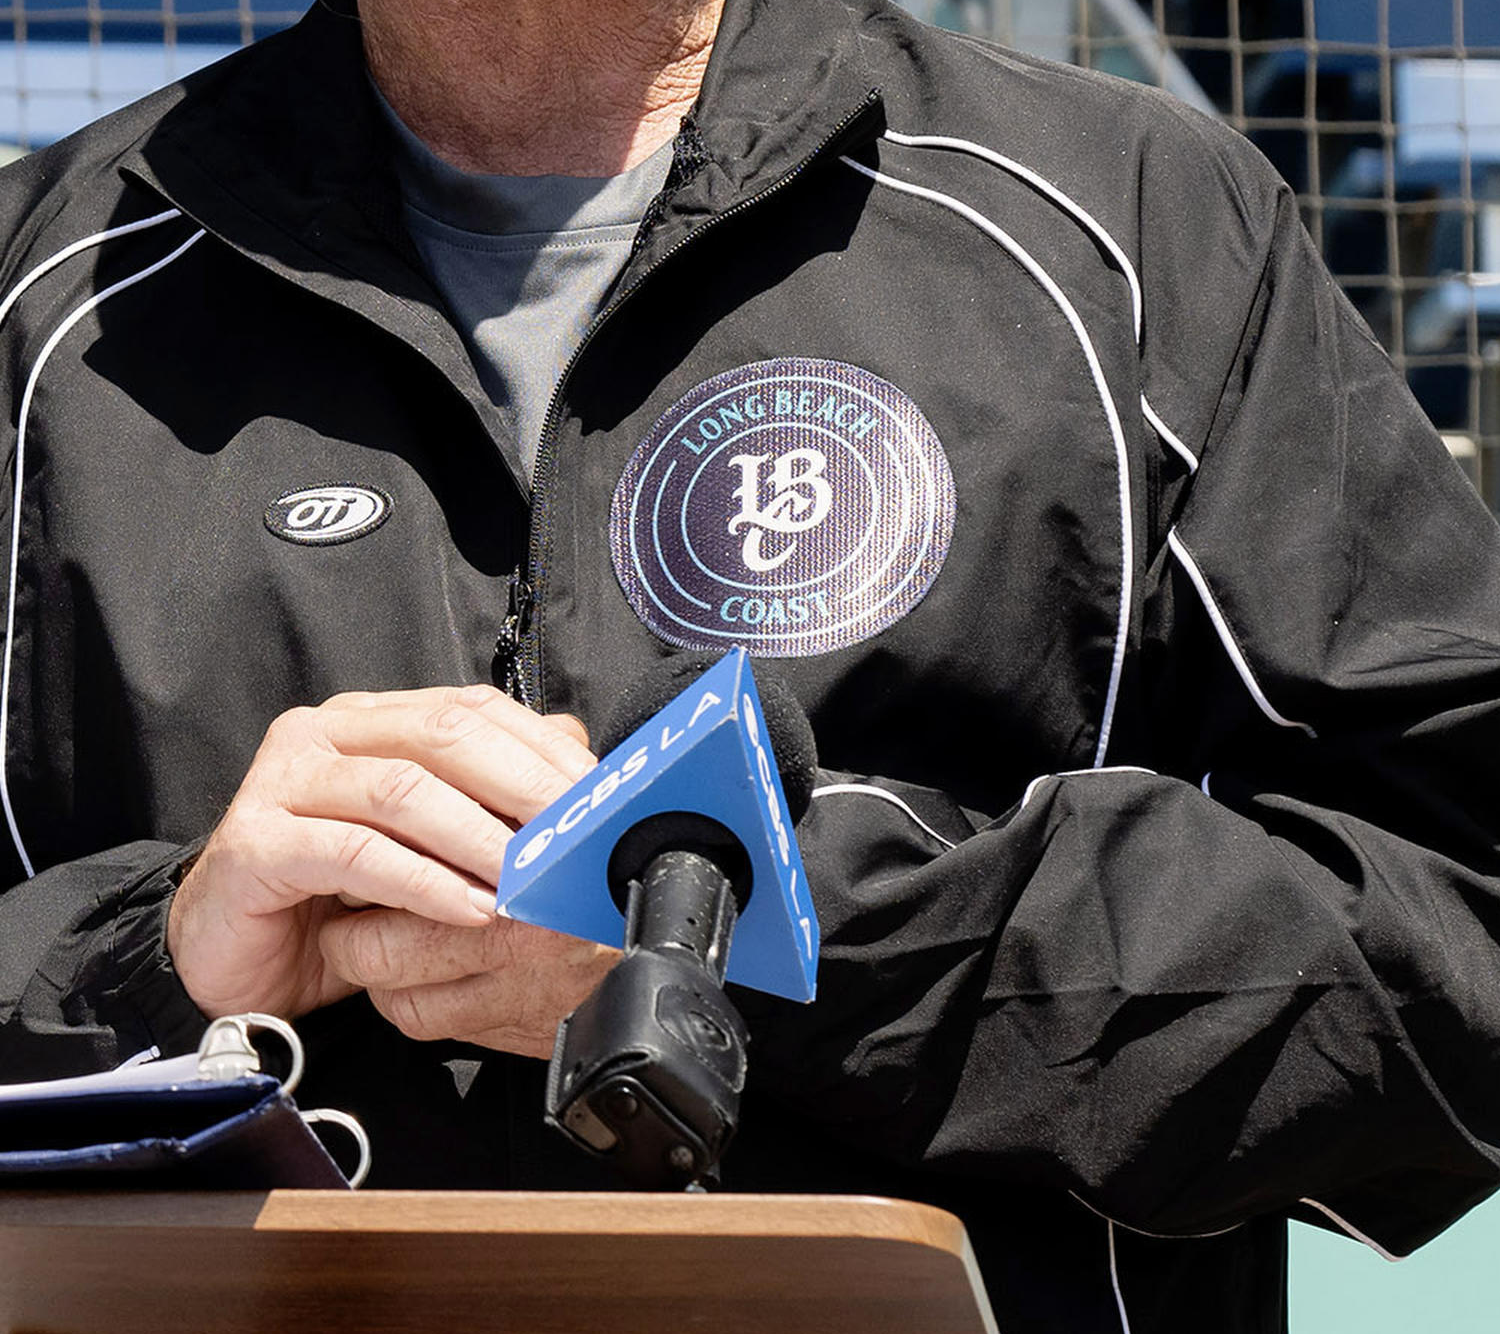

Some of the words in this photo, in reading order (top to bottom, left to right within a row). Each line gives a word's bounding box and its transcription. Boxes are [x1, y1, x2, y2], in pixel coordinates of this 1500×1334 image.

[680, 394, 765, 456] LONG
[774, 389, 880, 440] BEACH
[719, 591, 830, 626] COAST
[555, 745, 649, 835] CBS
[660, 691, 723, 751] LA
[756, 744, 790, 867] CBS
